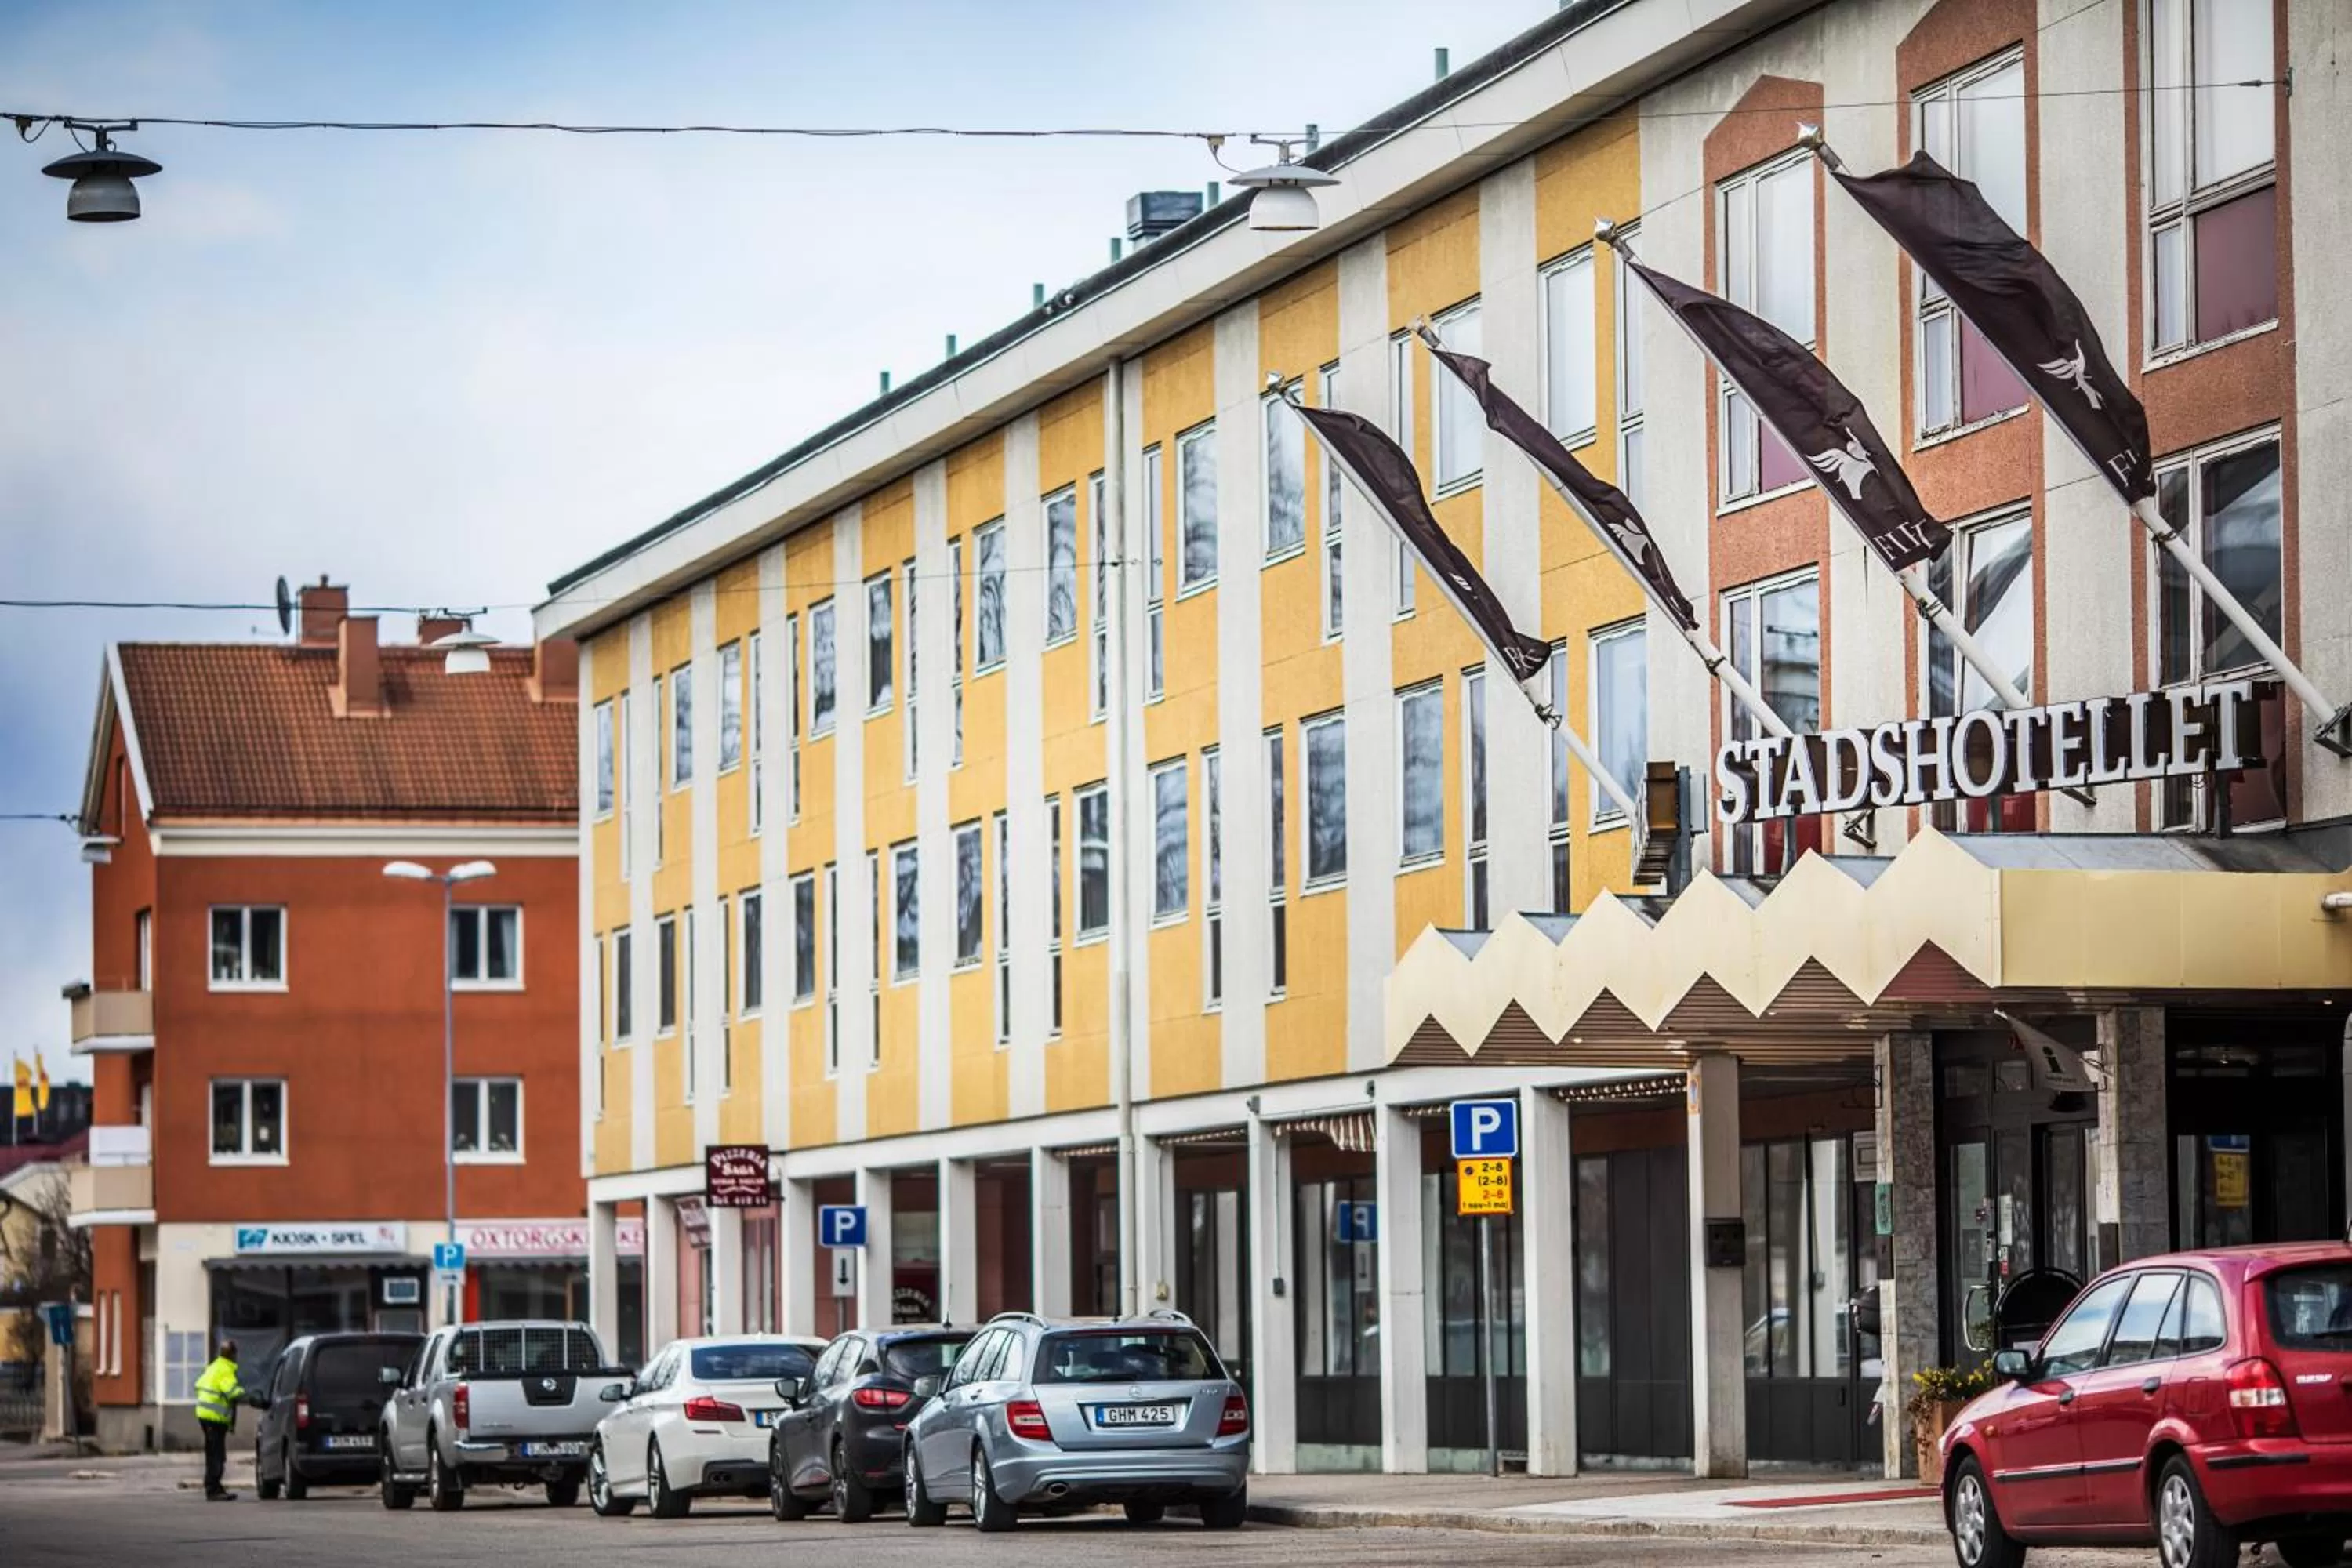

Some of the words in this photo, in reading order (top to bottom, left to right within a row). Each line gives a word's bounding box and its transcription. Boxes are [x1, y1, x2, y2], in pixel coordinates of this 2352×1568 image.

[1715, 680, 2252, 825] STADSHOTELLET
[1471, 1106, 1501, 1151] P
[710, 1148, 766, 1169] PIZZERIA
[1482, 1163, 1504, 1172] 2-8
[835, 1210, 856, 1243] P
[272, 1232, 318, 1245] KIOSK
[331, 1232, 367, 1245] SPEL
[444, 1247, 457, 1268] P
[1109, 1409, 1136, 1421] GHM
[1141, 1408, 1169, 1420] 425
